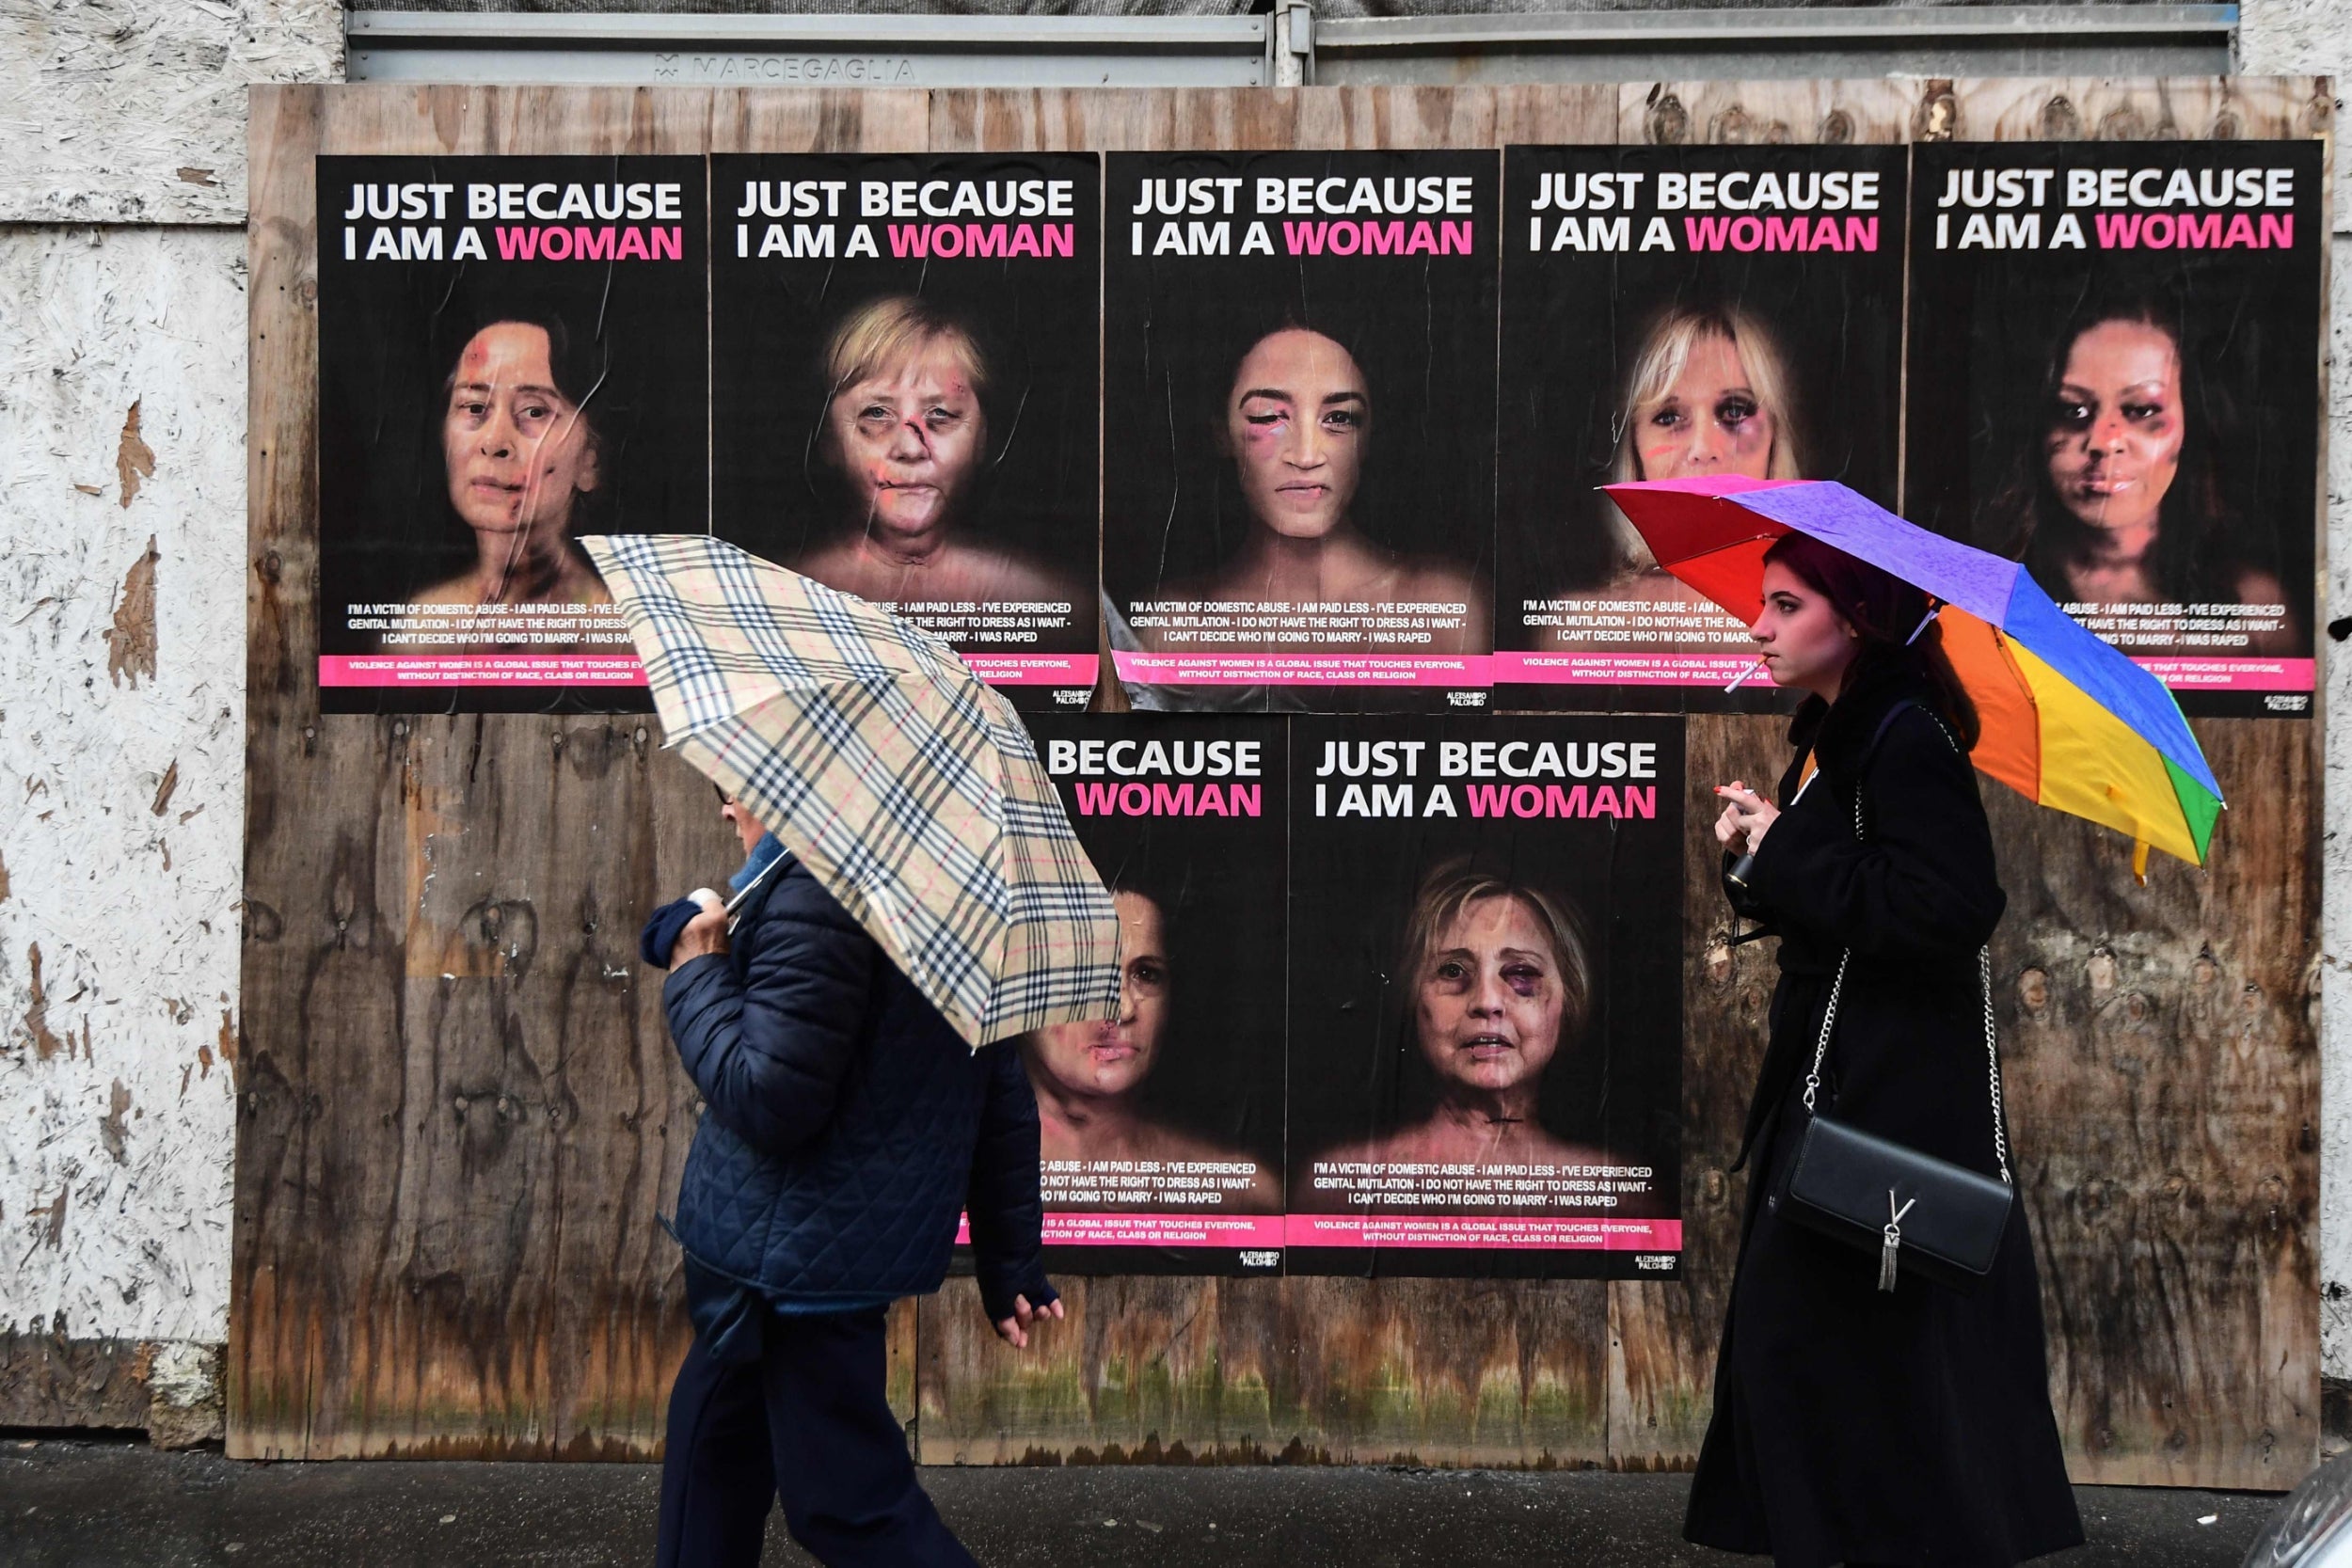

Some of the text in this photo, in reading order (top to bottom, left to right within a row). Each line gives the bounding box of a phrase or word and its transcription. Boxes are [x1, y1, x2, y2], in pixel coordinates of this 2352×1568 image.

[693, 57, 914, 80] MARCEGAGLIA
[345, 183, 681, 219] JUST BECAUSE
[738, 181, 1073, 216] JUST BECAUSE
[1133, 177, 1472, 214] JUST BECAUSE
[1532, 172, 1879, 210] JUST BECAUSE
[1938, 168, 2294, 207] JUST BECAUSE
[345, 227, 682, 261] I AM A WOMAN
[738, 224, 1073, 258] I AM A WOMAN
[1133, 221, 1472, 255] I AM A WOMAN
[1531, 216, 1878, 251] I AM A WOMAN
[1936, 214, 2293, 248] I AM A WOMAN
[905, 603, 1071, 612] I AM PAID LESS I'VE EXPERIENCED
[1130, 617, 1460, 628] GENITAL MUTILATION I DO NOT HAVE THE RIGHT TO DRESS AS I WANT
[1131, 602, 1466, 613] I'M A VICTIM OF DOMESTIC ABUSE I AM PAID LESS I'VE EXPERIENCED
[2063, 604, 2285, 616] ABUSE I AM PAID LESS I'VE EXPERIENCED
[382, 633, 612, 643] I CAN'T DECIDE WHO I'M GOING TO MARRY I WAS
[1164, 632, 1431, 642] I CAN'T DECIDE WHO I'M GOING TO MARRY I WAS RAPED
[1558, 630, 1721, 642] I CAN'T DECIDE WHO I'M GOING TO
[1021, 660, 1071, 669] EVERYONE,
[1414, 661, 1465, 670] EVERYONE,
[1049, 740, 1261, 777] BECAUSE
[1316, 741, 1656, 778] JUST BECAUSE
[1076, 783, 1261, 816] WOMAN
[1316, 784, 1655, 818] I AM A WOMAN
[1050, 1176, 1250, 1189] NOT HAVE THE RIGHT TO DRESS AS I WANT
[1314, 1163, 1652, 1177] I'M A VICTIM OF DOMESTIC ABUSE I AM PAID LESS I'VE EXPERIENCED
